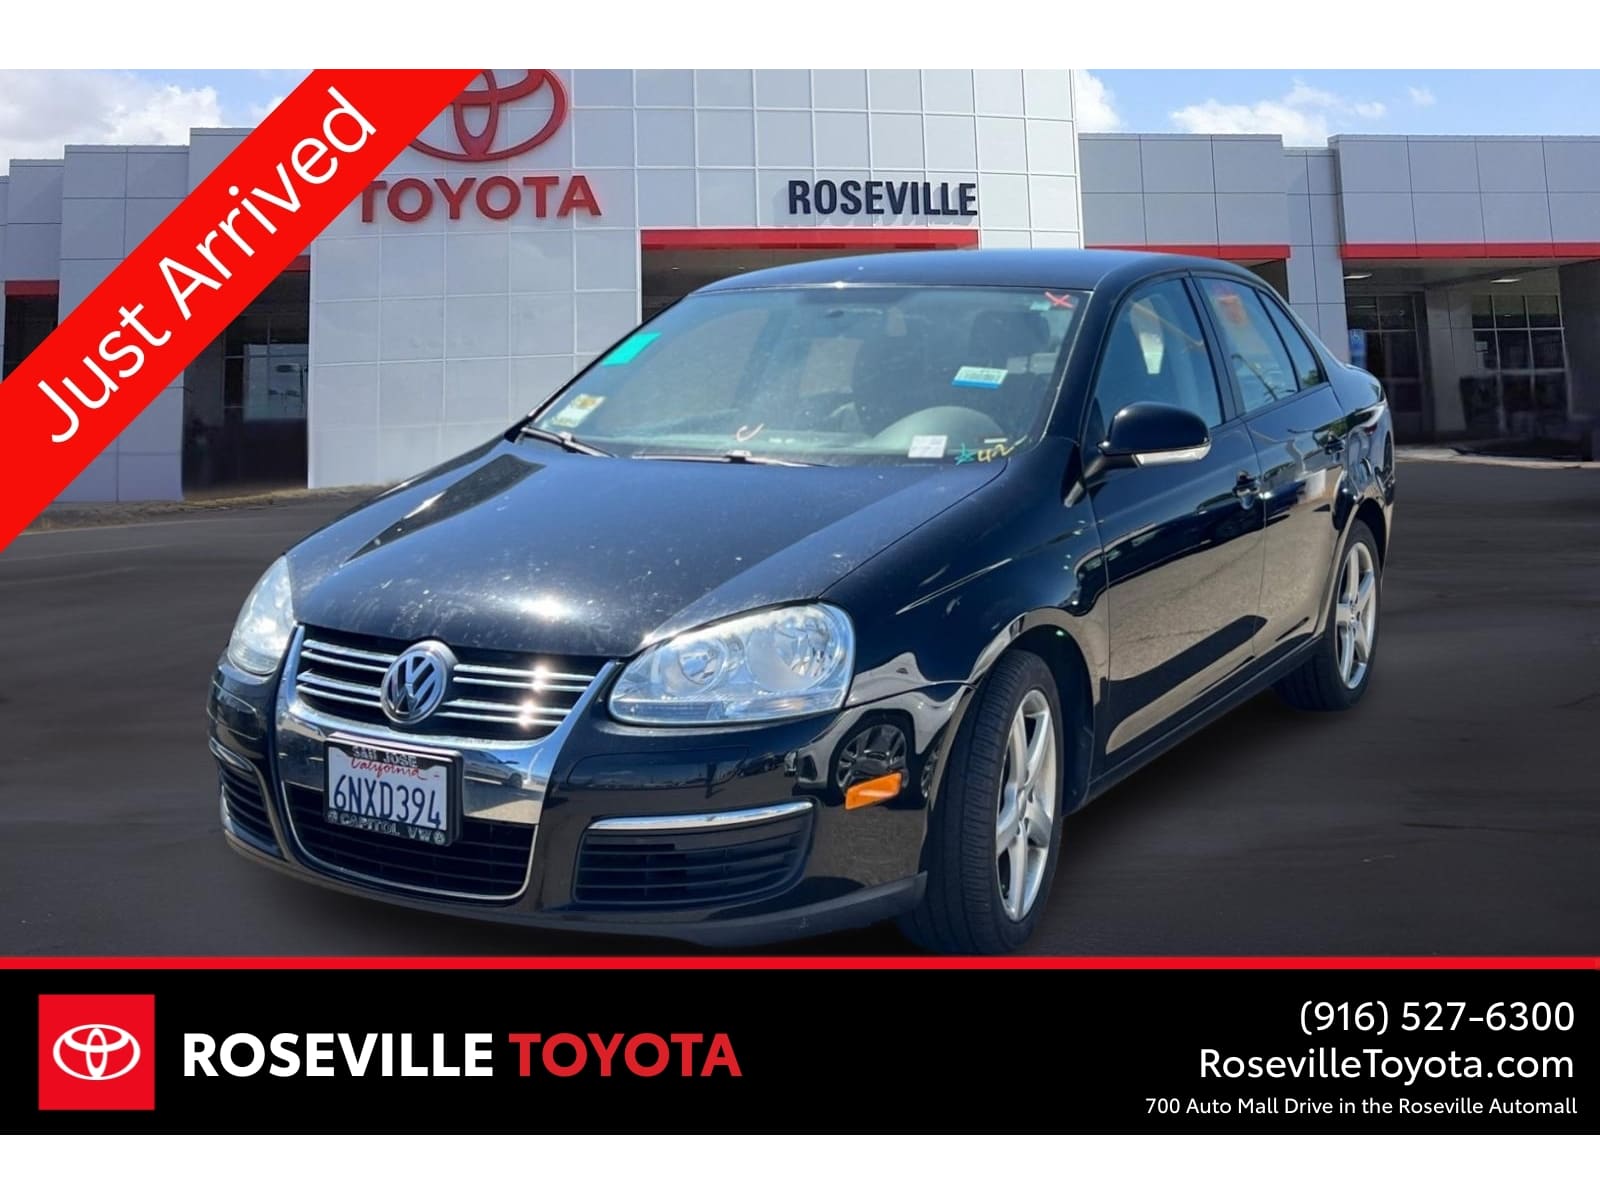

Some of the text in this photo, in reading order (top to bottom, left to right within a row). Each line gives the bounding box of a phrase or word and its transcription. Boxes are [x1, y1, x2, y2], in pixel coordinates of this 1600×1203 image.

[361, 175, 602, 223] TOYOTA
[788, 179, 978, 216] ROSEVILLE
[351, 746, 418, 768] SAN JOSE
[333, 774, 441, 830] 6NXD394
